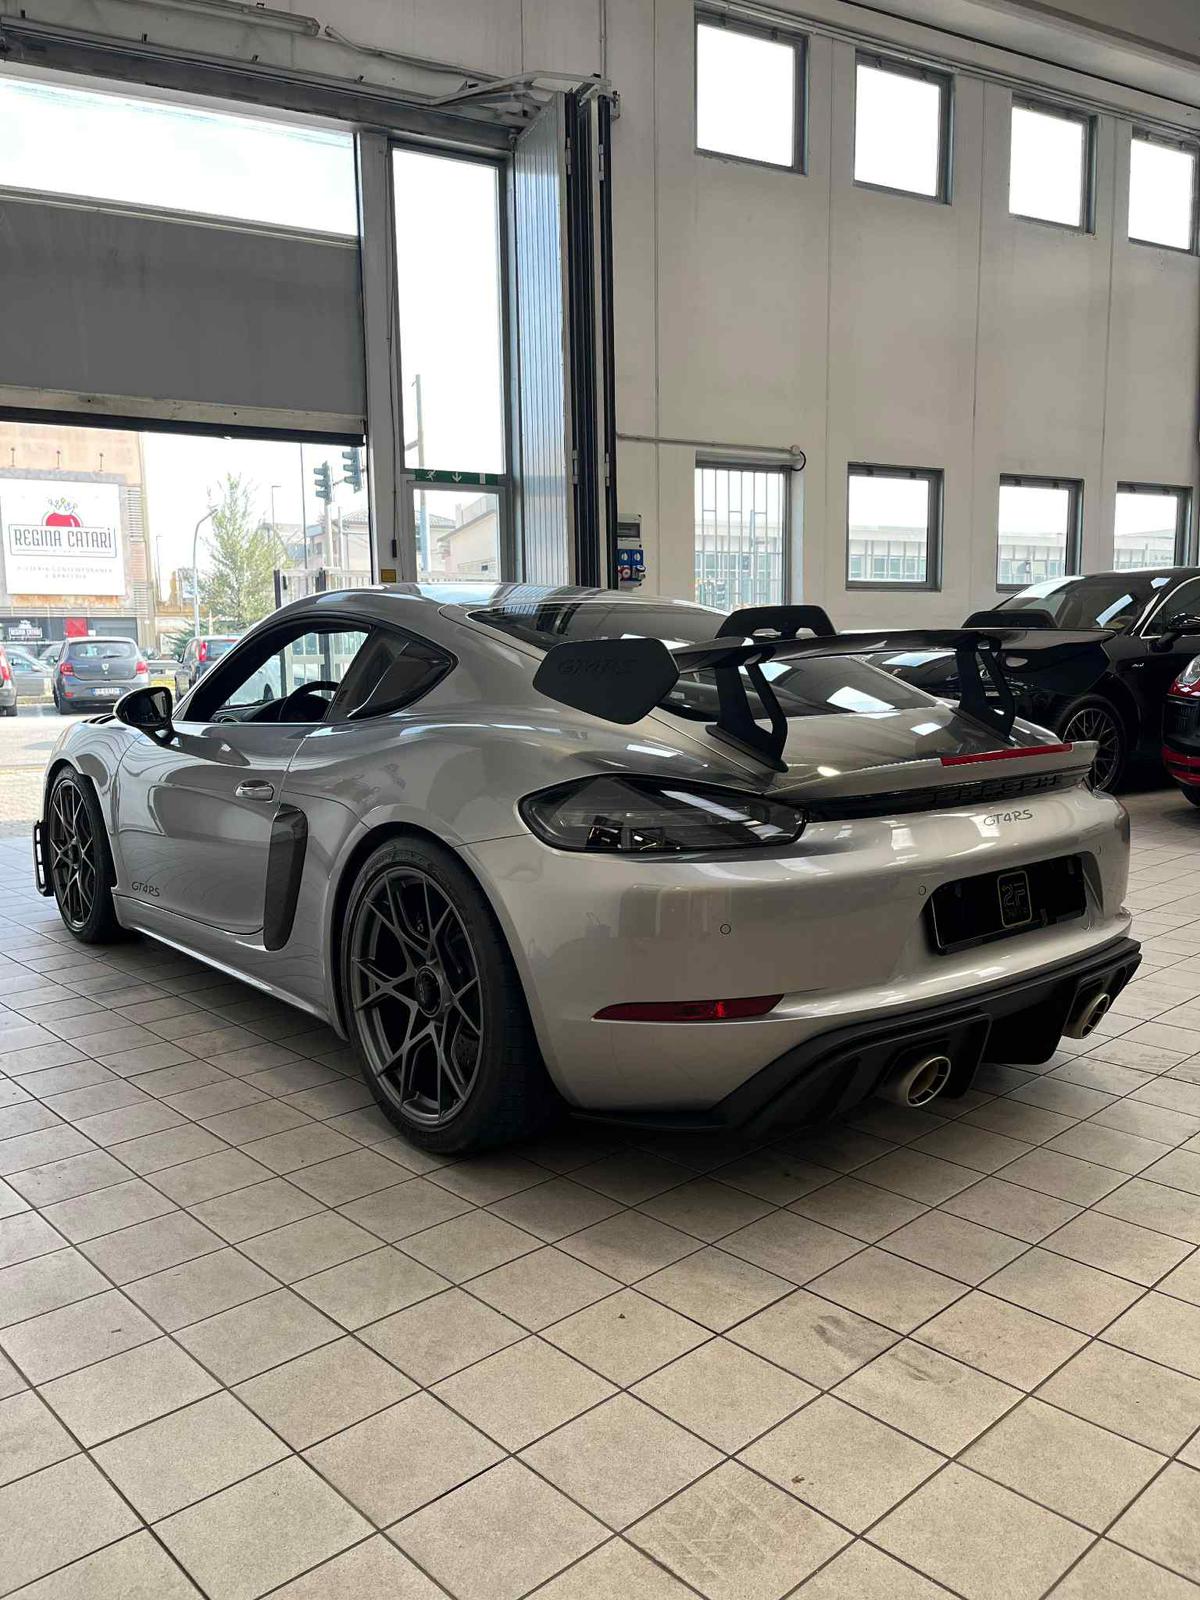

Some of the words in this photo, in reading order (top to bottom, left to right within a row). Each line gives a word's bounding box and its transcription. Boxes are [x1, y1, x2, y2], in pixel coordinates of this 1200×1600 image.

[14, 528, 62, 547] REGINA
[983, 809, 1033, 826] GT4RS
[131, 881, 160, 897] GT4RS
